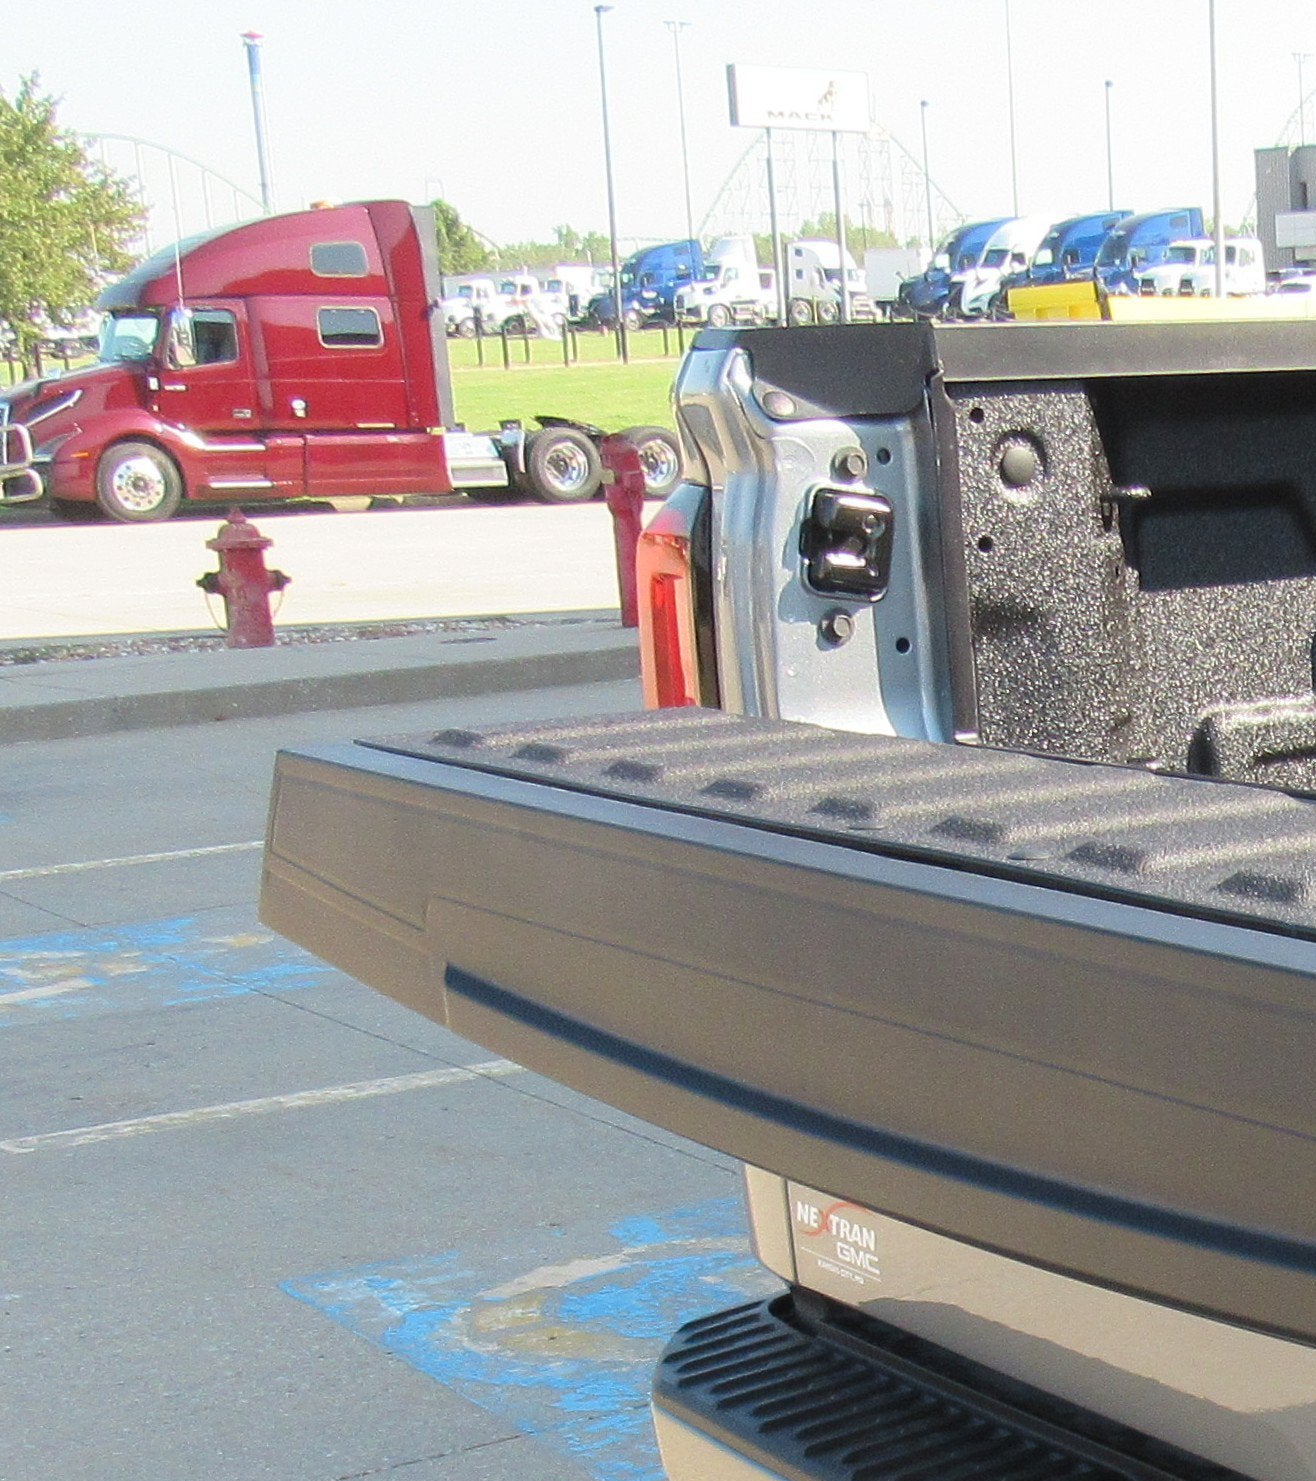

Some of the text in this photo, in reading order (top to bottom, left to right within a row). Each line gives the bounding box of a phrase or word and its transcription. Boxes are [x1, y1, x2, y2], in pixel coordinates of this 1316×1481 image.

[767, 110, 832, 121] MACK
[797, 1201, 876, 1251] NEXTRAN
[836, 1241, 881, 1275] GMC
